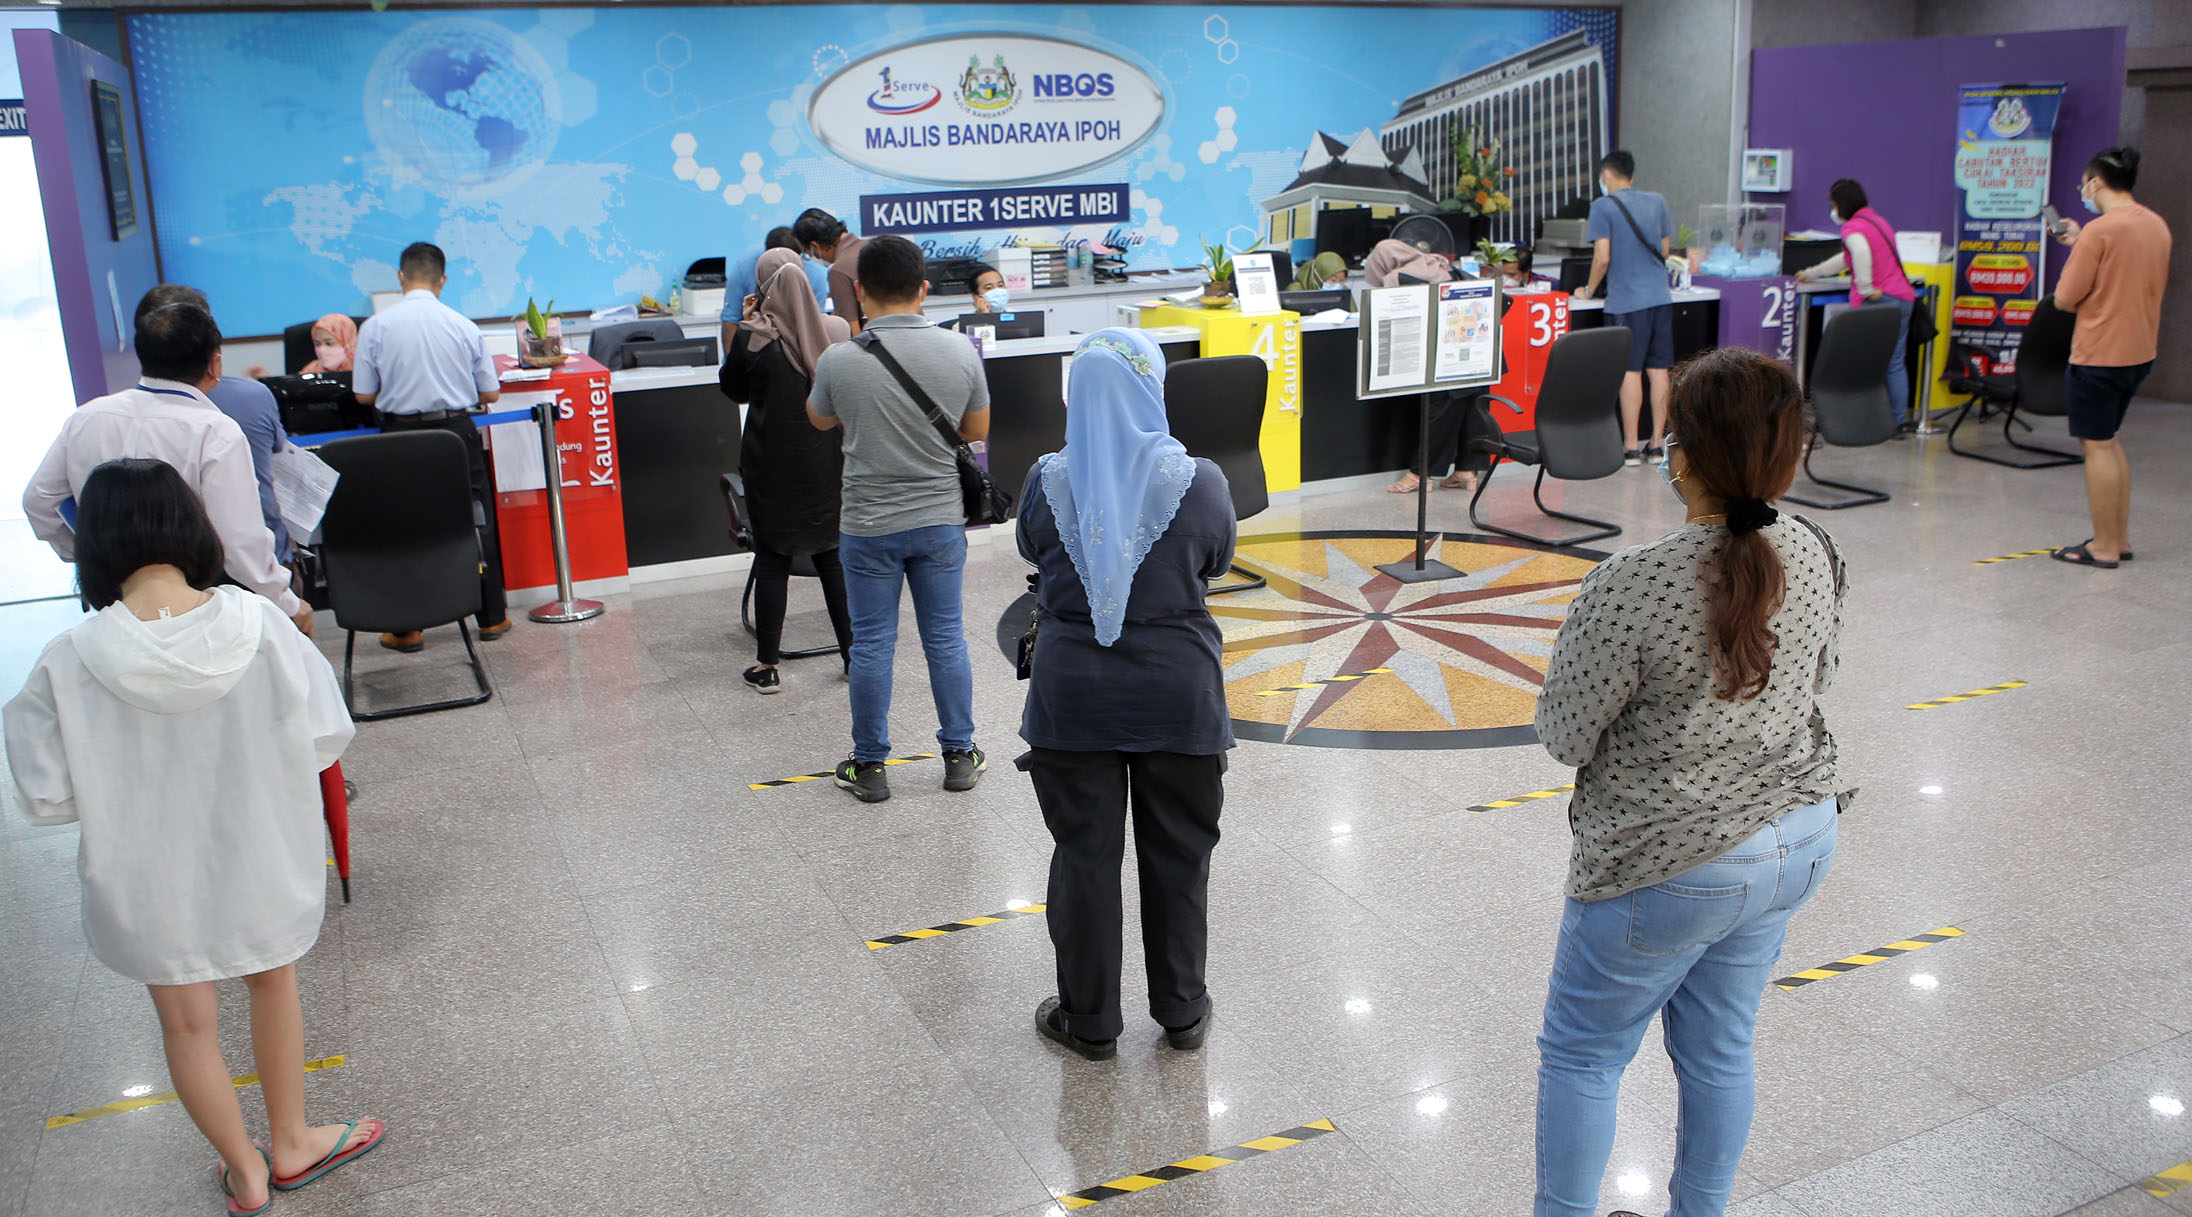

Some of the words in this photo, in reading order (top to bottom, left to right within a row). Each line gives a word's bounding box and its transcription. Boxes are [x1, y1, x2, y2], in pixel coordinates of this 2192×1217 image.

[865, 125, 941, 150] MAJLIS
[947, 121, 1071, 146] BANDARAYA
[1075, 120, 1121, 142] IPOH
[872, 197, 984, 228] KAUNTER
[989, 194, 1074, 222] 1SERVE
[1079, 191, 1118, 217] MBI
[920, 236, 983, 258] Bersih
[1101, 229, 1146, 249] Maju
[1530, 302, 1552, 347] 3
[1761, 285, 1782, 328] 2
[1777, 280, 1796, 362] Kaunter
[1251, 324, 1280, 372] 4
[1279, 319, 1298, 412] Kaunter
[588, 378, 614, 486] Kaunter
